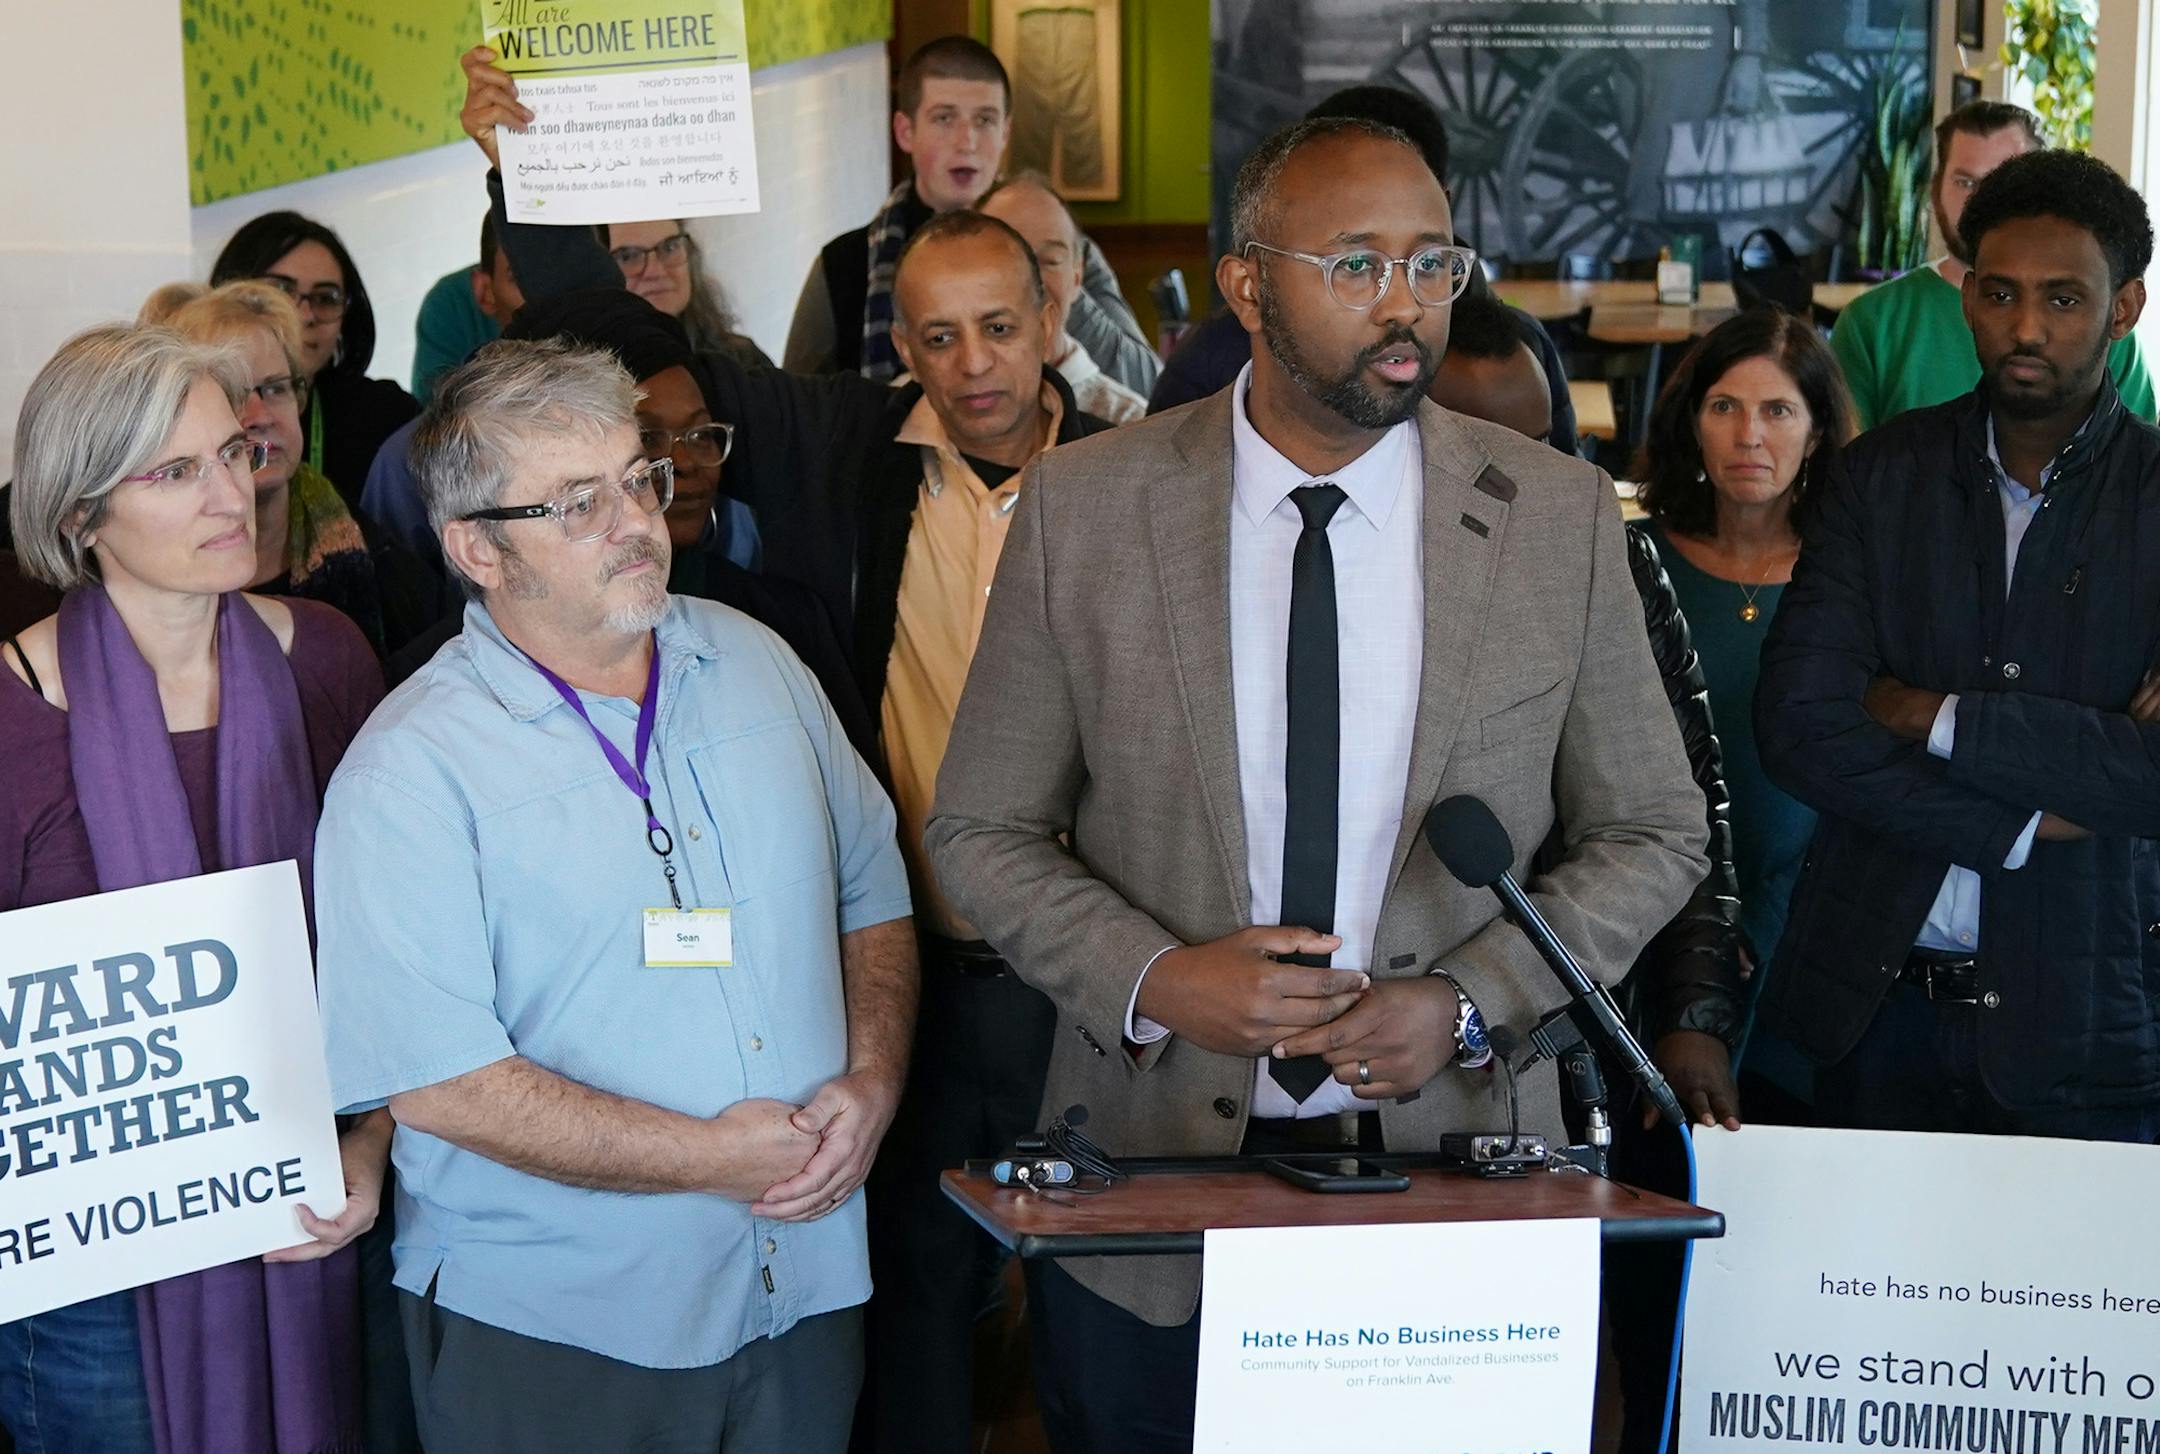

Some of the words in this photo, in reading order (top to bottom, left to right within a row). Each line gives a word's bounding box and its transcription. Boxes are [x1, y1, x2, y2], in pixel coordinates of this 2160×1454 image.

[488, 0, 528, 27] All
[536, 8, 570, 24] are
[499, 20, 636, 60] WELCOME
[645, 14, 717, 50] HERE
[540, 123, 561, 135] soo
[652, 112, 687, 128] dadka
[690, 113, 704, 125] oo
[707, 109, 736, 124] dhan
[676, 933, 700, 942] Sean
[66, 1157, 306, 1247] VIOLENCE
[1820, 1272, 1877, 1297] hate
[1887, 1275, 1930, 1300] has
[1938, 1283, 1971, 1303] no
[1981, 1281, 2093, 1310] business
[2103, 1287, 2160, 1314] here
[1242, 1330, 1297, 1348] Hate
[1306, 1329, 1350, 1347] Has
[1358, 1327, 1390, 1345] No
[1398, 1325, 1499, 1344] Business
[1507, 1323, 1561, 1341] Here
[1240, 1358, 1320, 1372] Community
[1324, 1357, 1379, 1371] Support
[1383, 1356, 1401, 1368] for
[1405, 1353, 1480, 1368] Vandalized
[1484, 1351, 1560, 1365] Businesses
[1774, 1351, 1841, 1380] we
[1858, 1349, 1989, 1390] stand
[2006, 1355, 2106, 1397] with
[1346, 1376, 1364, 1388] on
[1367, 1374, 1422, 1388] Franklin
[1426, 1373, 1456, 1386] Ave.
[1709, 1391, 1846, 1444] MUSLIM
[1858, 1400, 2072, 1454] COMMUNITY
